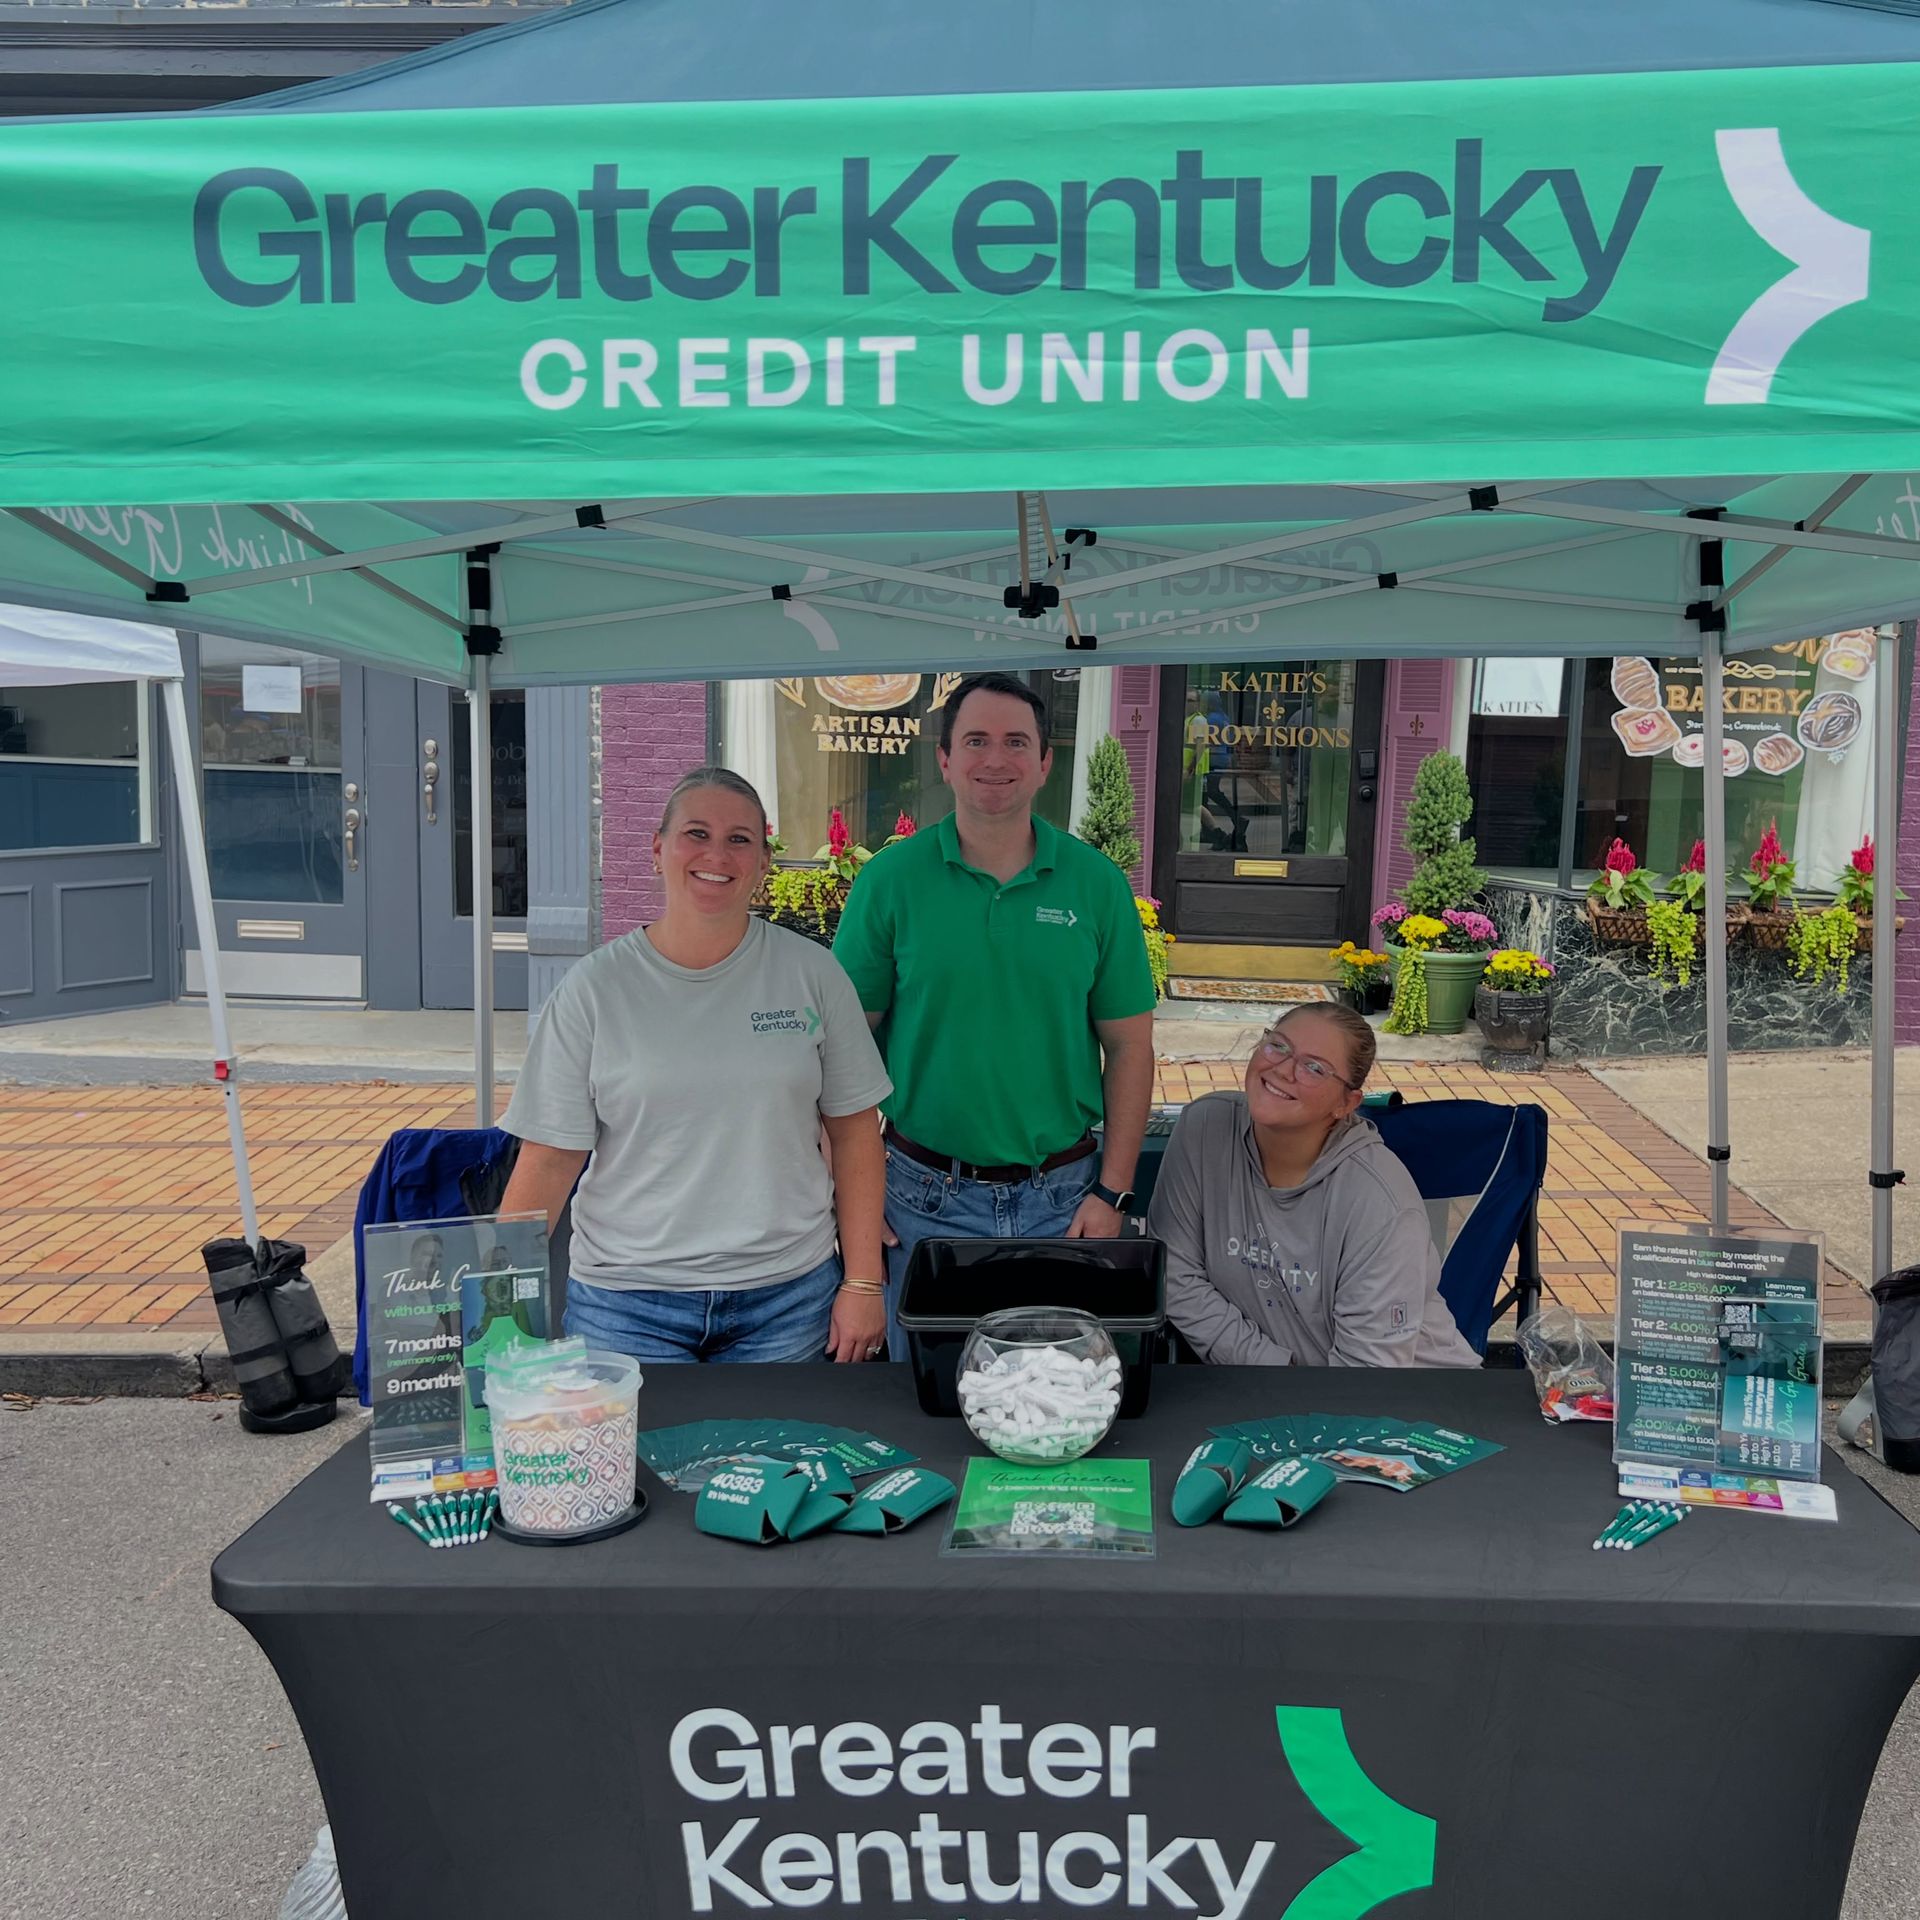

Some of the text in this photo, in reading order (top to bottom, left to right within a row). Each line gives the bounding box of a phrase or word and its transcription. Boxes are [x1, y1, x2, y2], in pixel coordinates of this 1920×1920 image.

[193, 138, 1664, 323] Greater Kentucky
[520, 328, 1310, 410] CREDIT UNION
[1220, 671, 1327, 694] KATIE'S
[811, 713, 921, 736] ARTISAN
[817, 734, 911, 755] BAKERY
[750, 1009, 797, 1022] Greater
[752, 1019, 807, 1032] Kentucky
[1632, 1243, 1651, 1251] Earn
[1652, 1244, 1666, 1253] the
[1667, 1246, 1688, 1255] rates
[1689, 1248, 1697, 1256] in
[1722, 1250, 1734, 1260] by
[1734, 1252, 1769, 1263] meeting
[1770, 1254, 1785, 1263] the
[1632, 1253, 1687, 1265] qualifications
[1688, 1257, 1696, 1265] in
[1715, 1260, 1737, 1269] each
[1737, 1261, 1767, 1271] month.
[383, 1268, 445, 1298] Think
[1632, 1277, 1736, 1295] Tier 1: 2.25% APY
[384, 1305, 413, 1318] with
[414, 1303, 435, 1316] our
[1631, 1318, 1711, 1335] Tier 2: 4.00%
[385, 1334, 462, 1354] 7 months
[1693, 1335, 1719, 1345] $25,00
[1630, 1362, 1710, 1380] Tier 3: 5.00%
[387, 1379, 400, 1394] 9
[1692, 1380, 1717, 1390] $25,00
[1634, 1418, 1701, 1435] 3.00% APY
[710, 1473, 765, 1494] 40383
[669, 1704, 1157, 1801] Greater
[681, 1812, 1276, 1920] Kentucky
